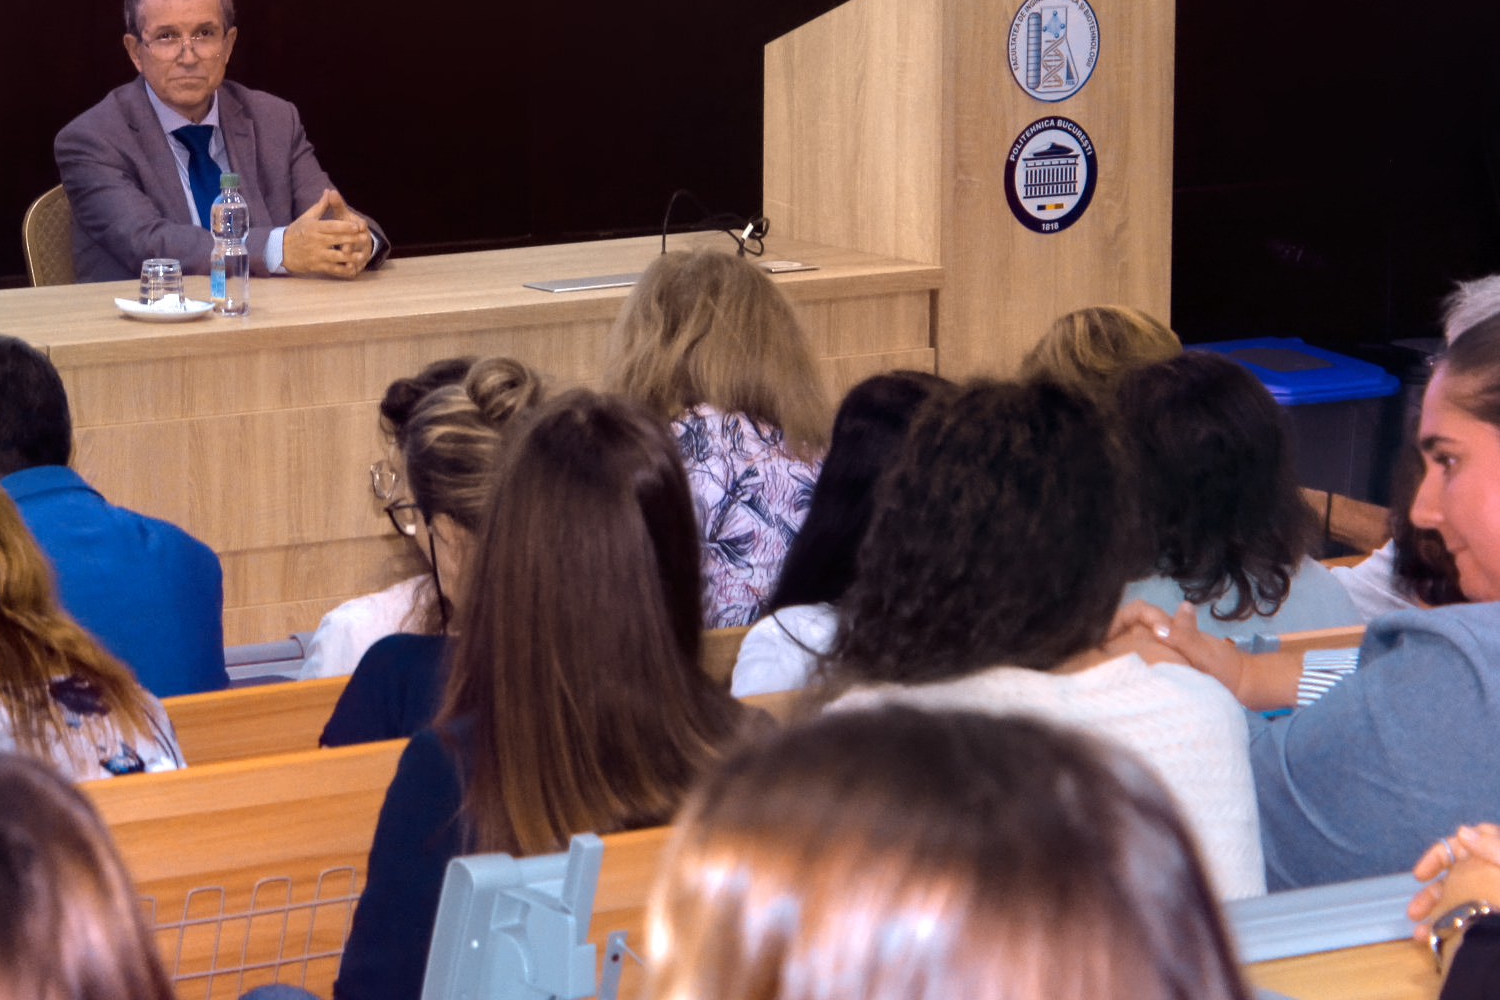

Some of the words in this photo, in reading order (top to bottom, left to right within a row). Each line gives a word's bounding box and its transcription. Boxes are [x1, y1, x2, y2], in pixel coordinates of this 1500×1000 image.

[1010, 22, 1021, 71] FACULTATEA
[1017, 11, 1027, 25] DE
[1009, 119, 1056, 162] POLITEHNICA
[1041, 222, 1060, 231] 1818
